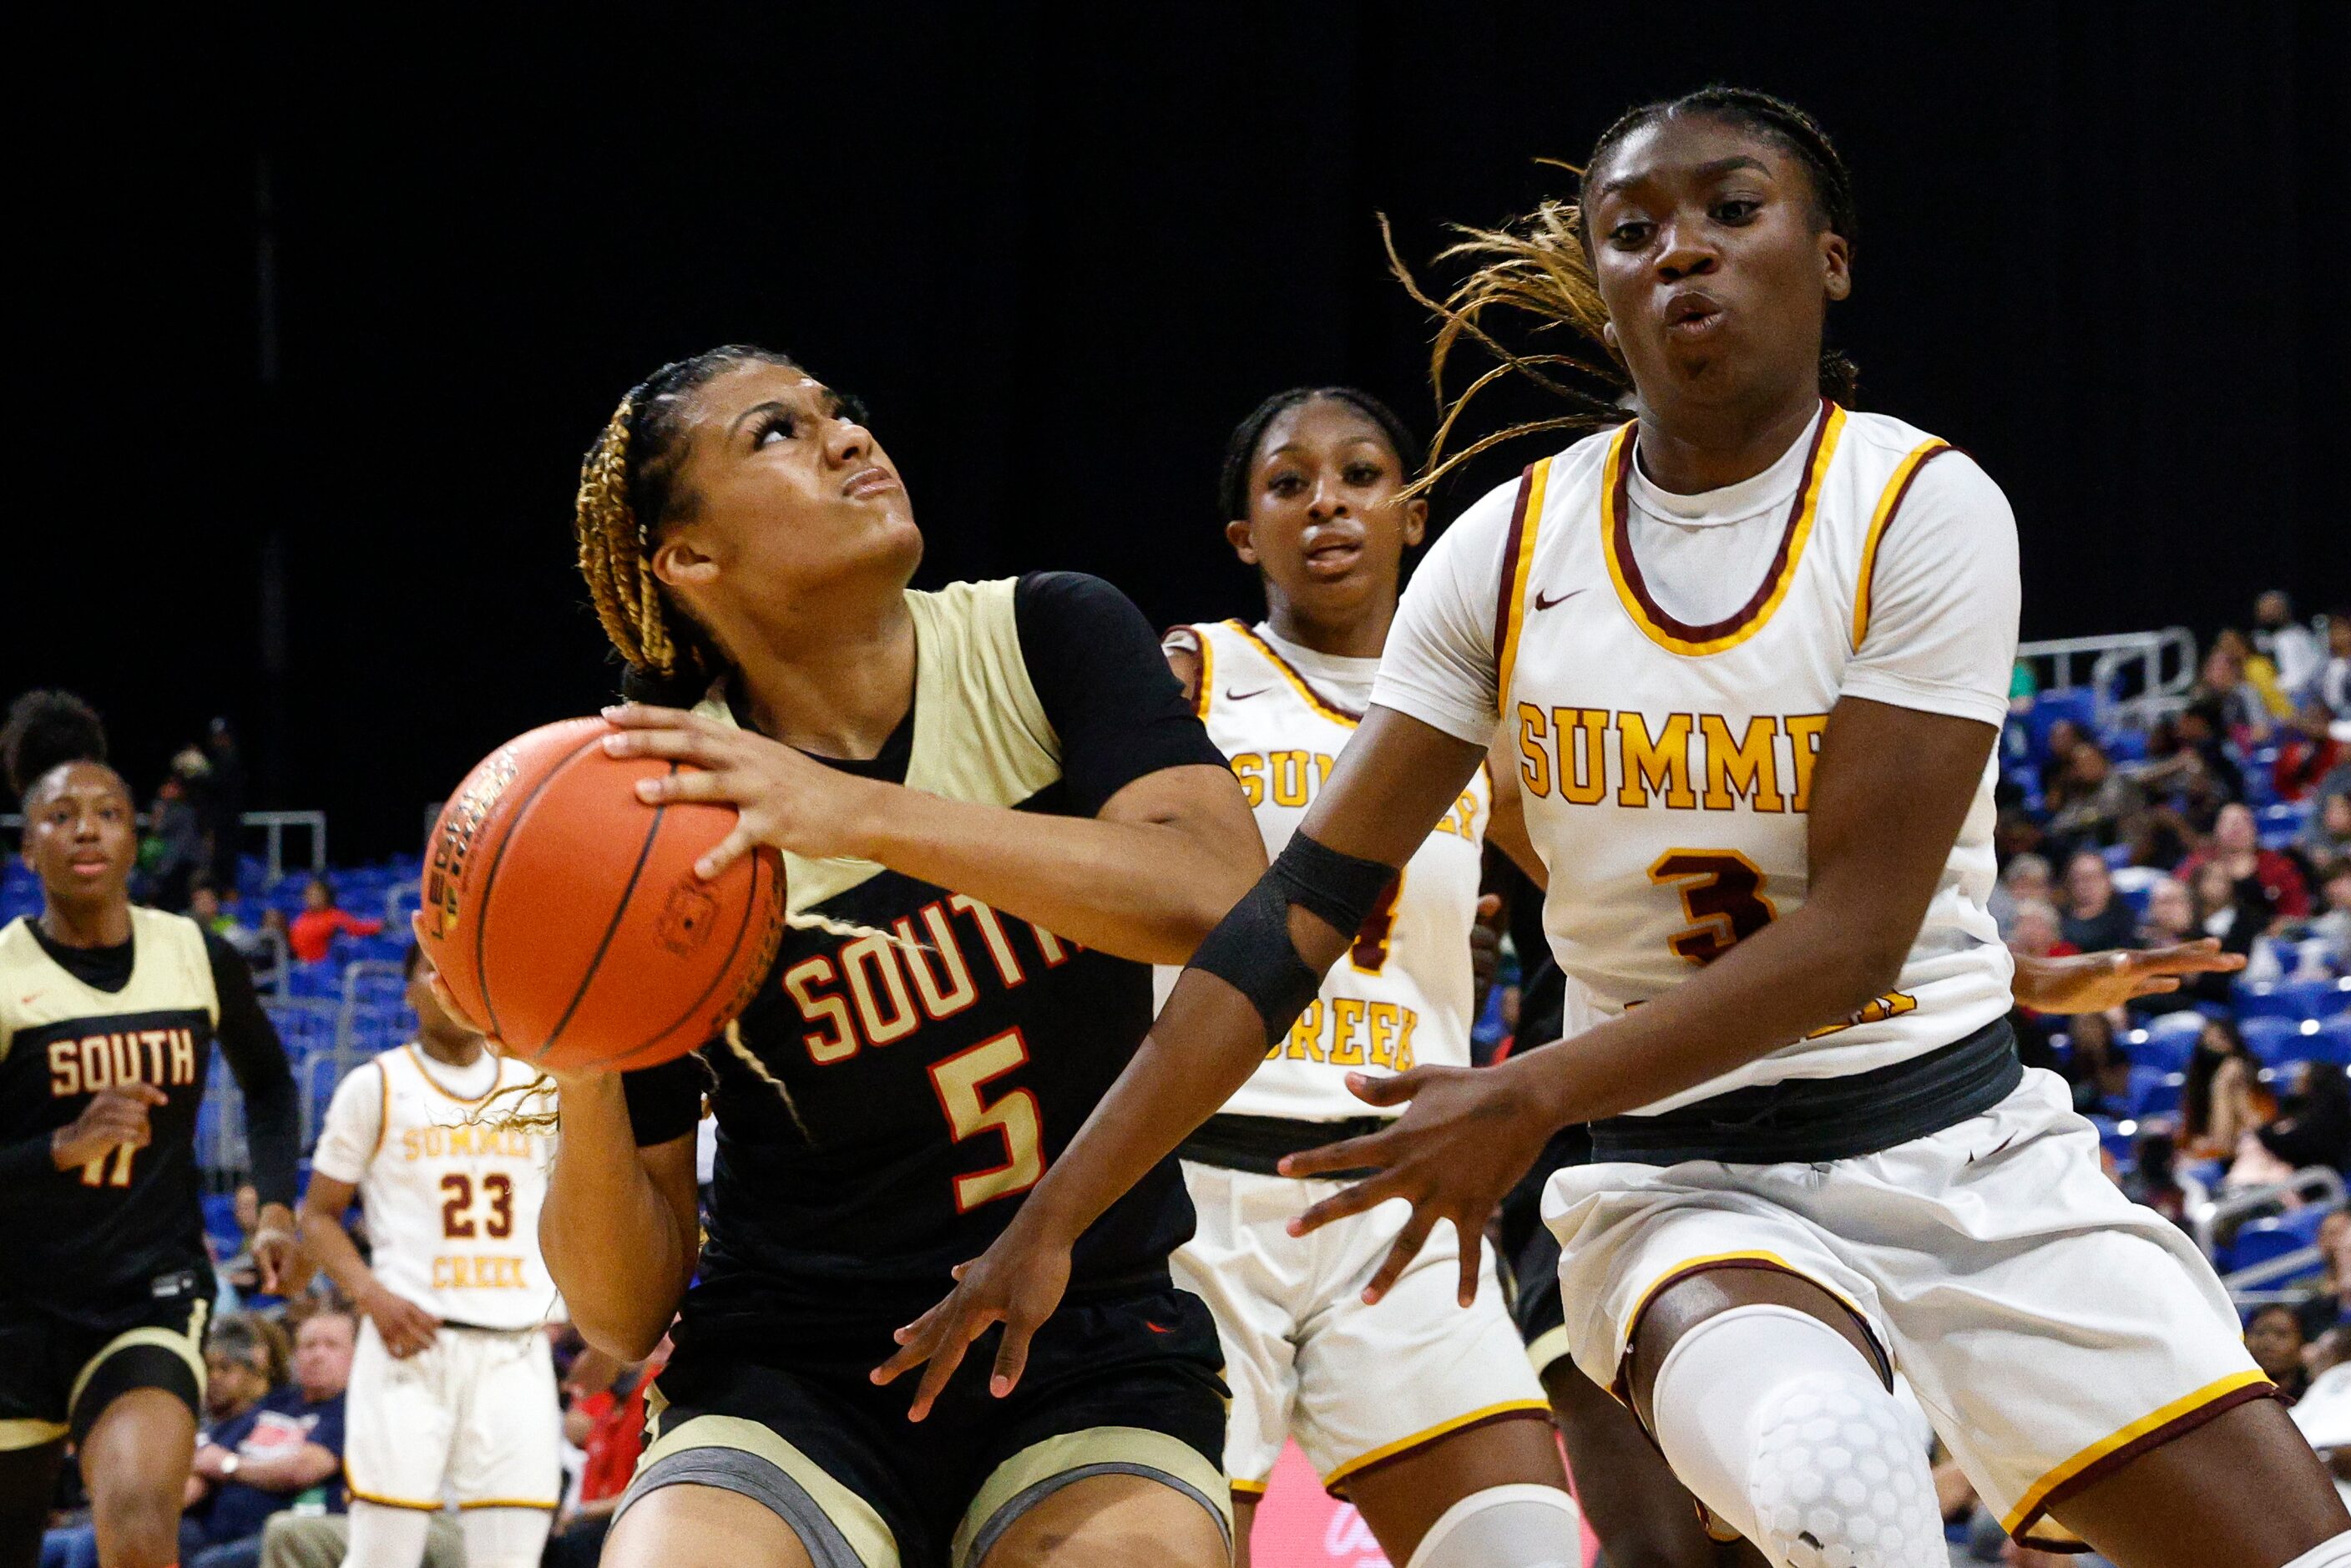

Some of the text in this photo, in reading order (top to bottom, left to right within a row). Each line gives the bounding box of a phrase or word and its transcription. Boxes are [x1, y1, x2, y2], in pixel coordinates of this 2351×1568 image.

[1517, 701, 1830, 813] SUMME
[1646, 847, 1778, 967] 3
[48, 1027, 197, 1099] SOUTH
[1265, 998, 1418, 1073] REEK
[927, 1024, 1046, 1216] 5
[439, 1171, 513, 1241] 23
[432, 1255, 529, 1290] CREEK
